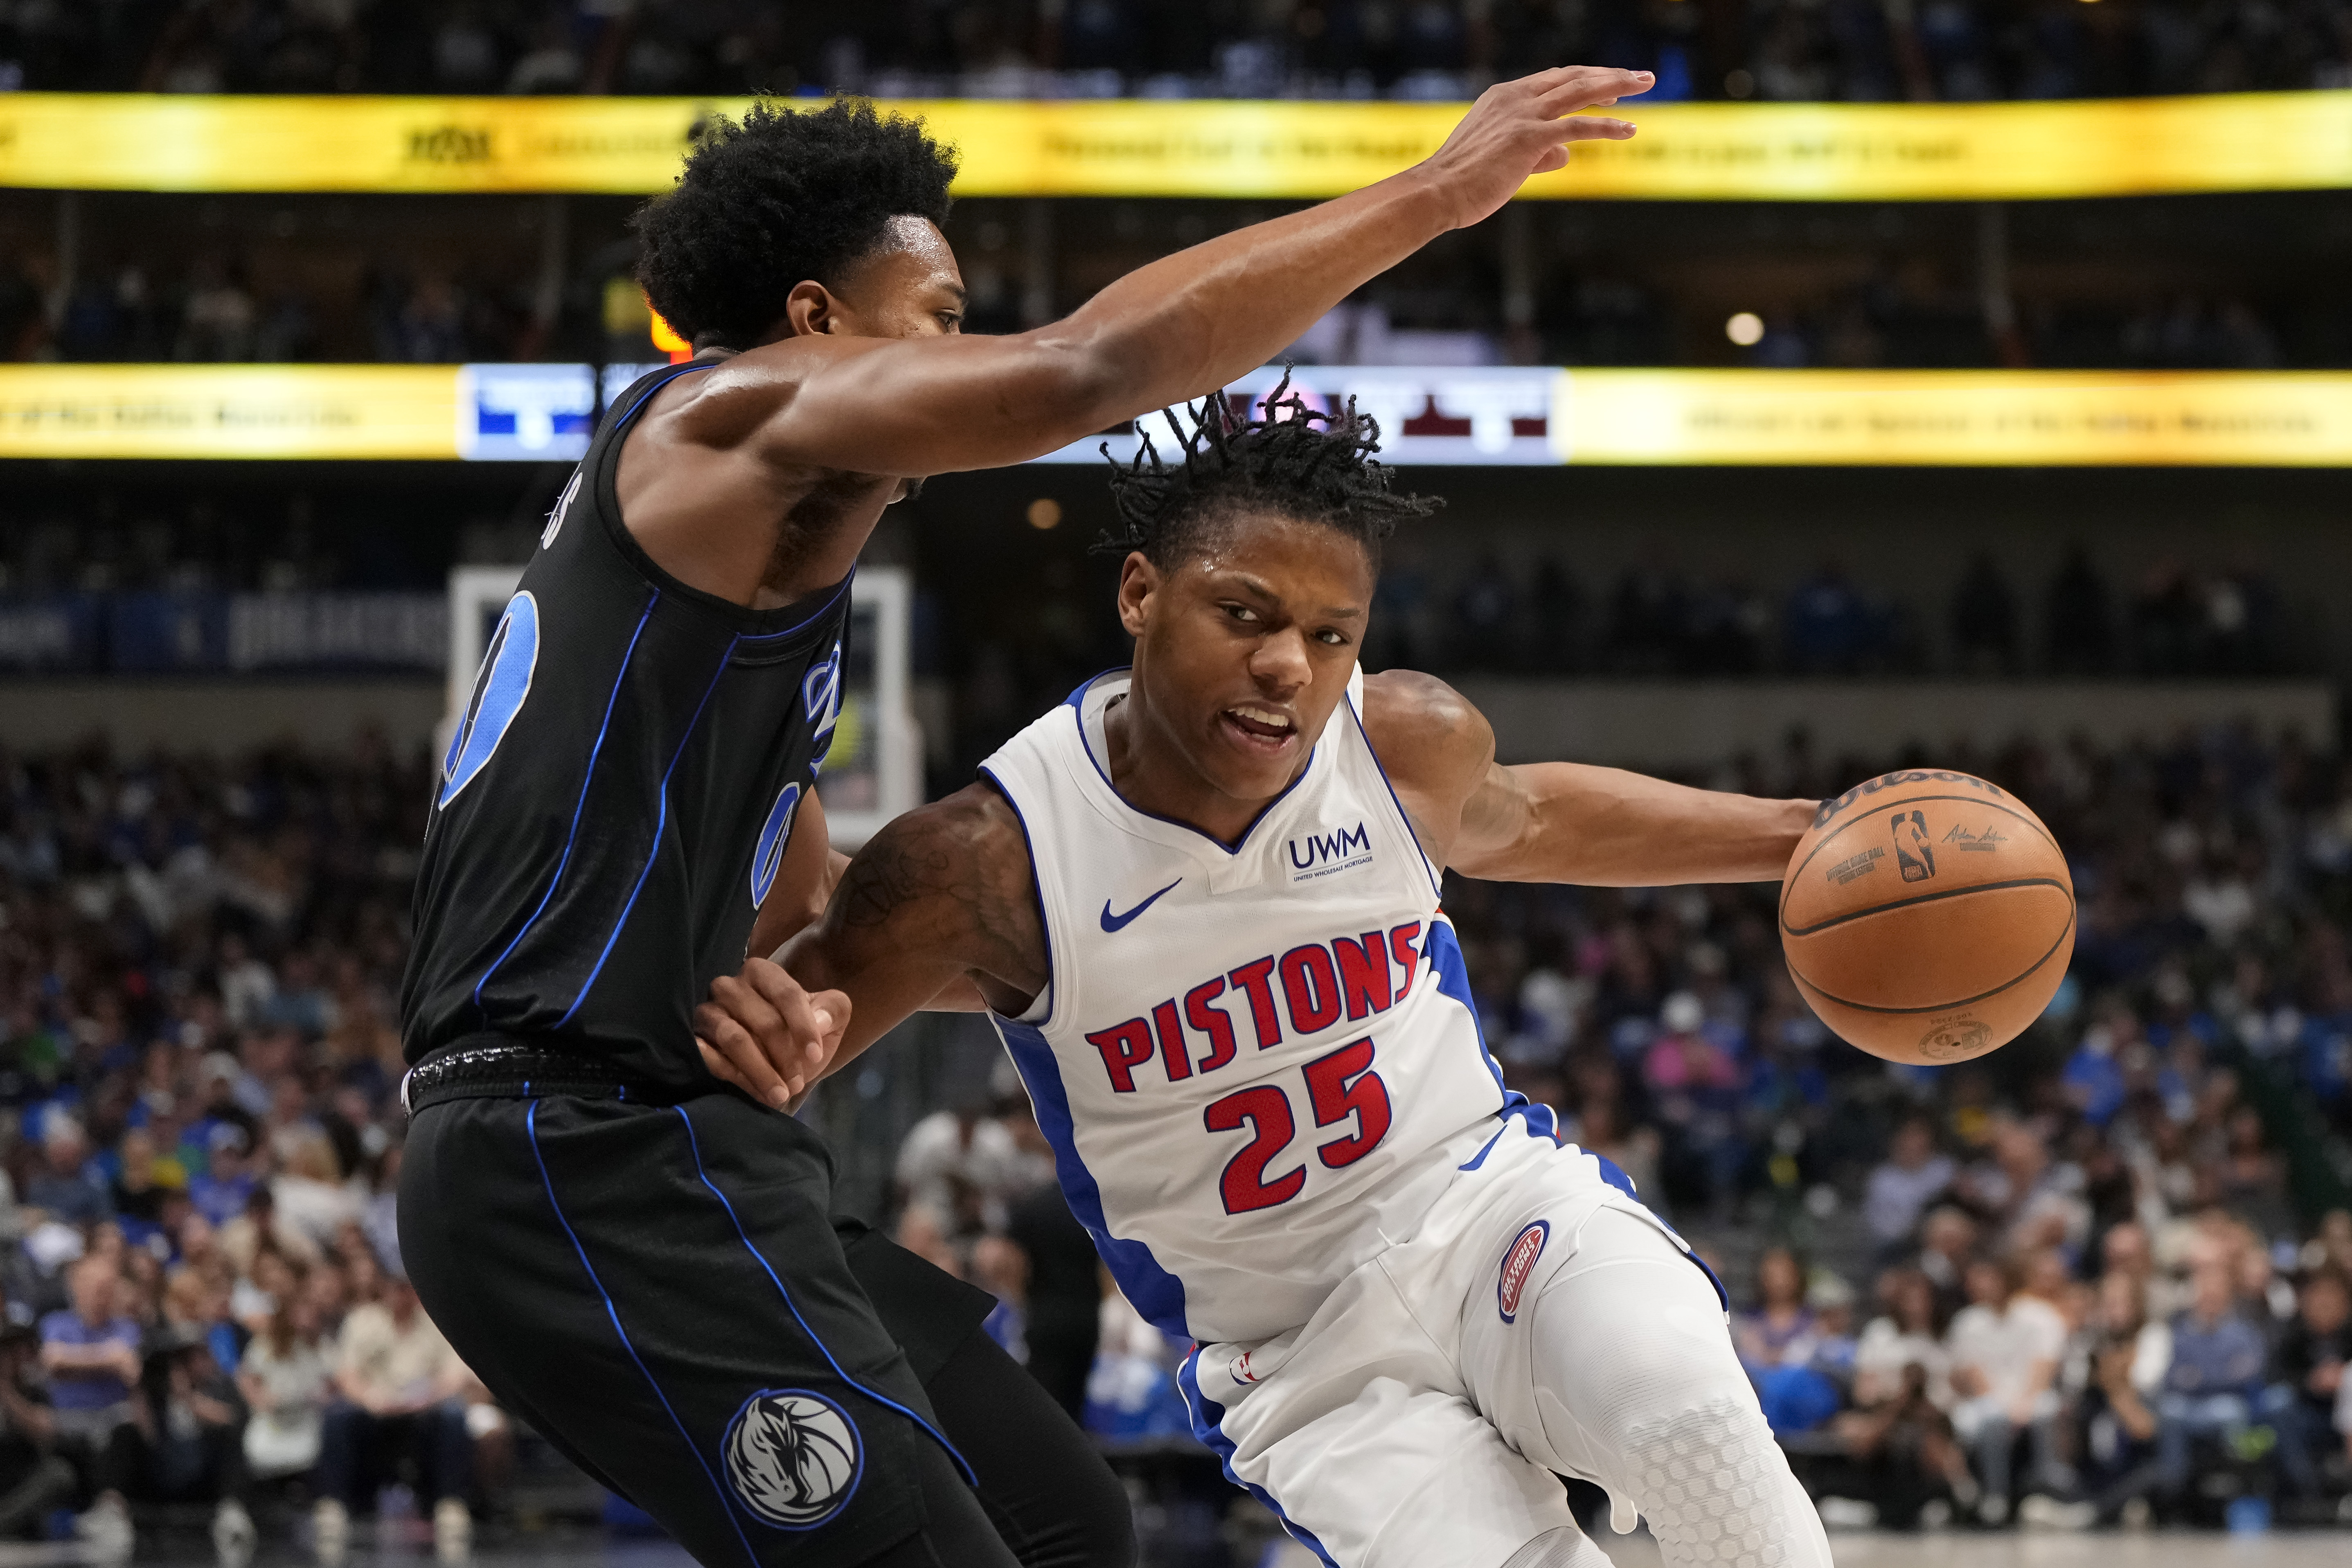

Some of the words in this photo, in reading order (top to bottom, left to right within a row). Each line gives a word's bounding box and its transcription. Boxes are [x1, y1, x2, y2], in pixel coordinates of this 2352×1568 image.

[1289, 820, 1371, 869] UWM
[1294, 873, 1313, 882] UNITED
[1314, 865, 1343, 878] WHOLESALE
[1344, 856, 1373, 870] MORTGAGE
[1085, 920, 1420, 1092] PISTONS
[1203, 1036, 1392, 1216] 25
[1503, 1235, 1532, 1296] DETROIT
[1506, 1241, 1535, 1304] PISTONS
